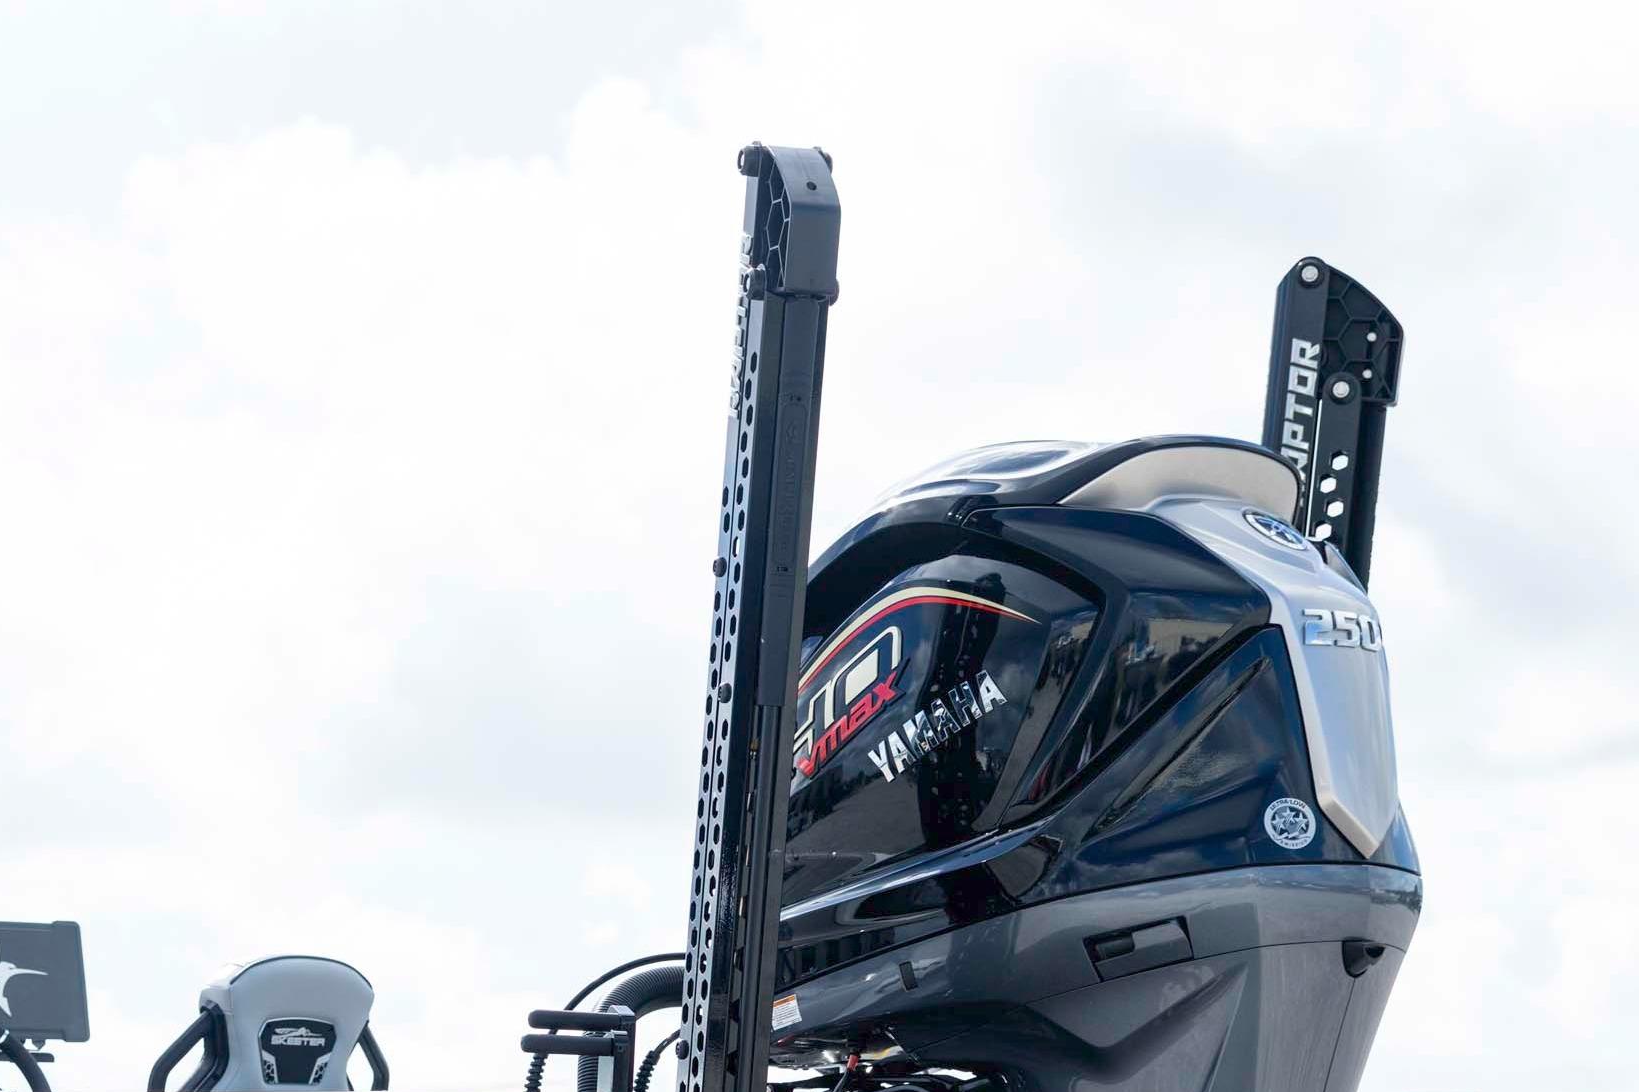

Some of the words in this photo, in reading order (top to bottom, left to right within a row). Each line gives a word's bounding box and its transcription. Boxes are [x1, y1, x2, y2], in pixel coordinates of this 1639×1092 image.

[1302, 608, 1383, 652] 250
[867, 669, 1008, 783] YAMAHA
[271, 1034, 326, 1047] SKEETER
